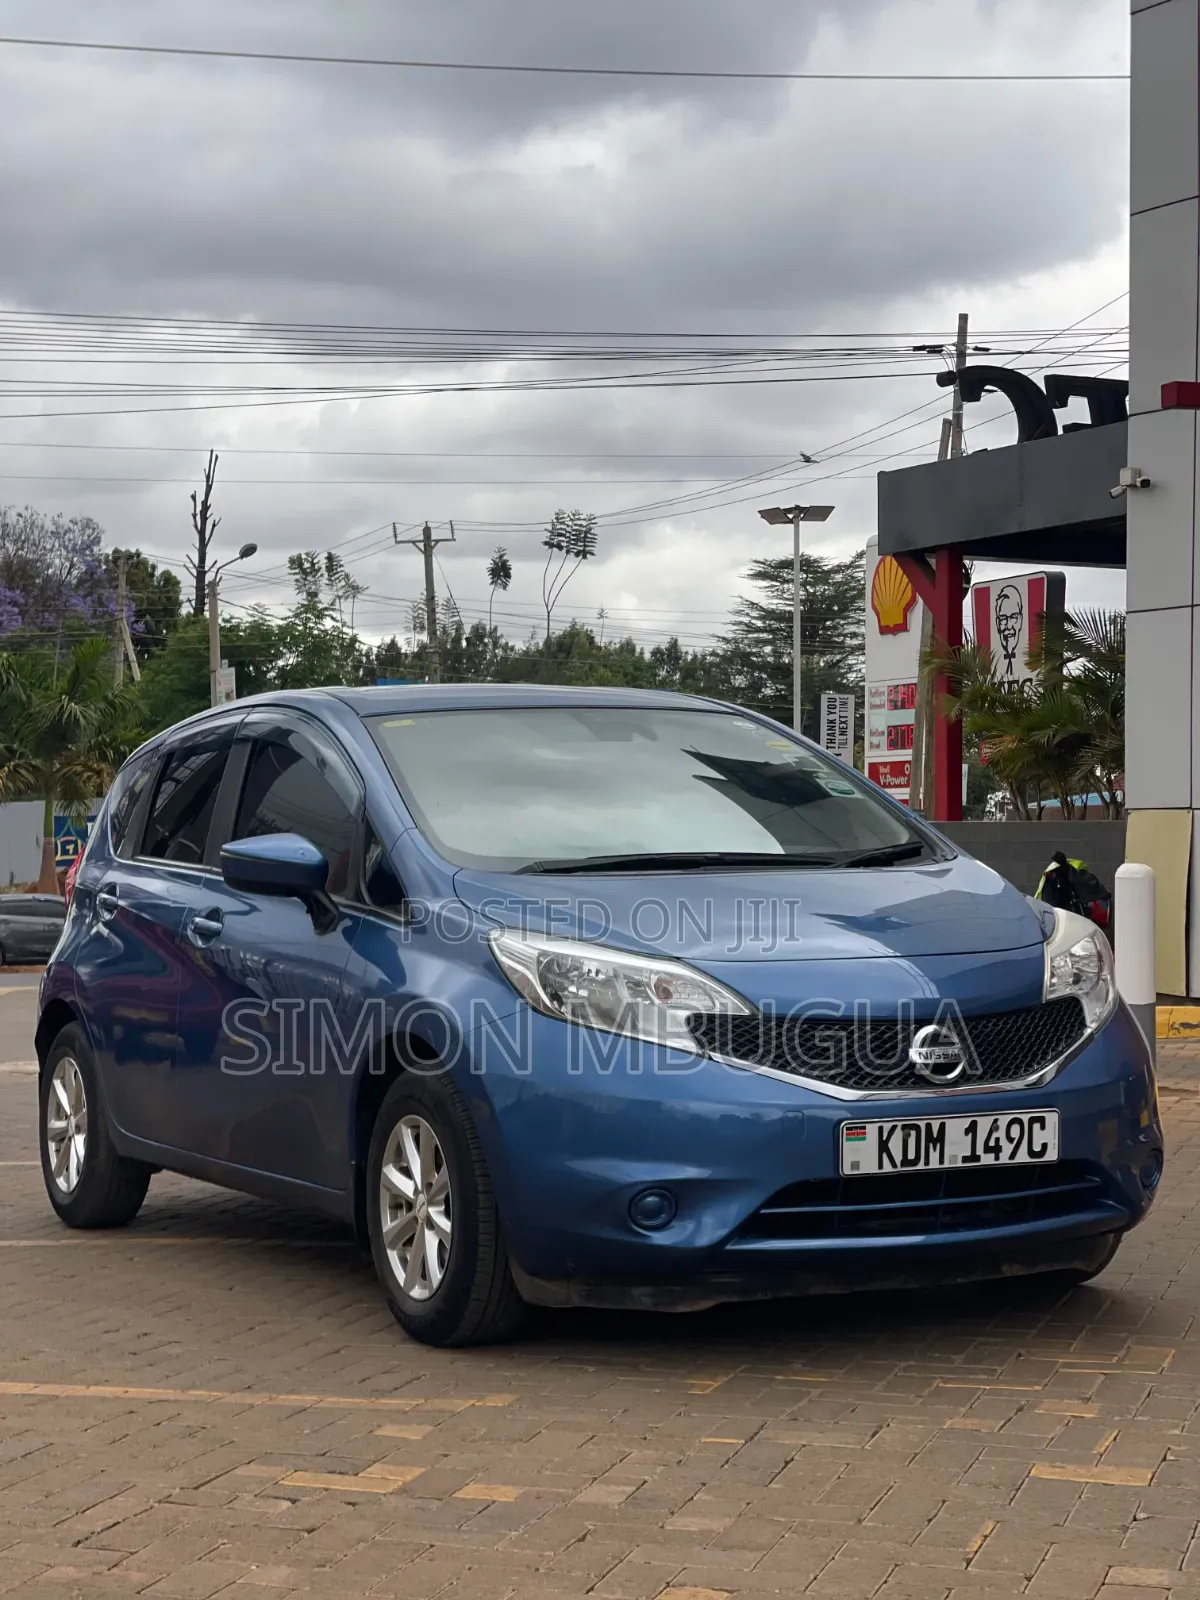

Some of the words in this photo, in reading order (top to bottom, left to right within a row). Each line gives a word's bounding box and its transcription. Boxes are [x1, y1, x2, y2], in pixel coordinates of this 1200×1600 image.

[826, 697, 837, 716] YOU
[838, 697, 849, 713] TIME
[826, 718, 837, 750] THANK
[838, 715, 849, 736] NEXT
[838, 738, 848, 749] TILL
[879, 776, 908, 786] V-Power
[877, 1121, 947, 1170] KDM
[961, 1115, 1049, 1164] 149C
